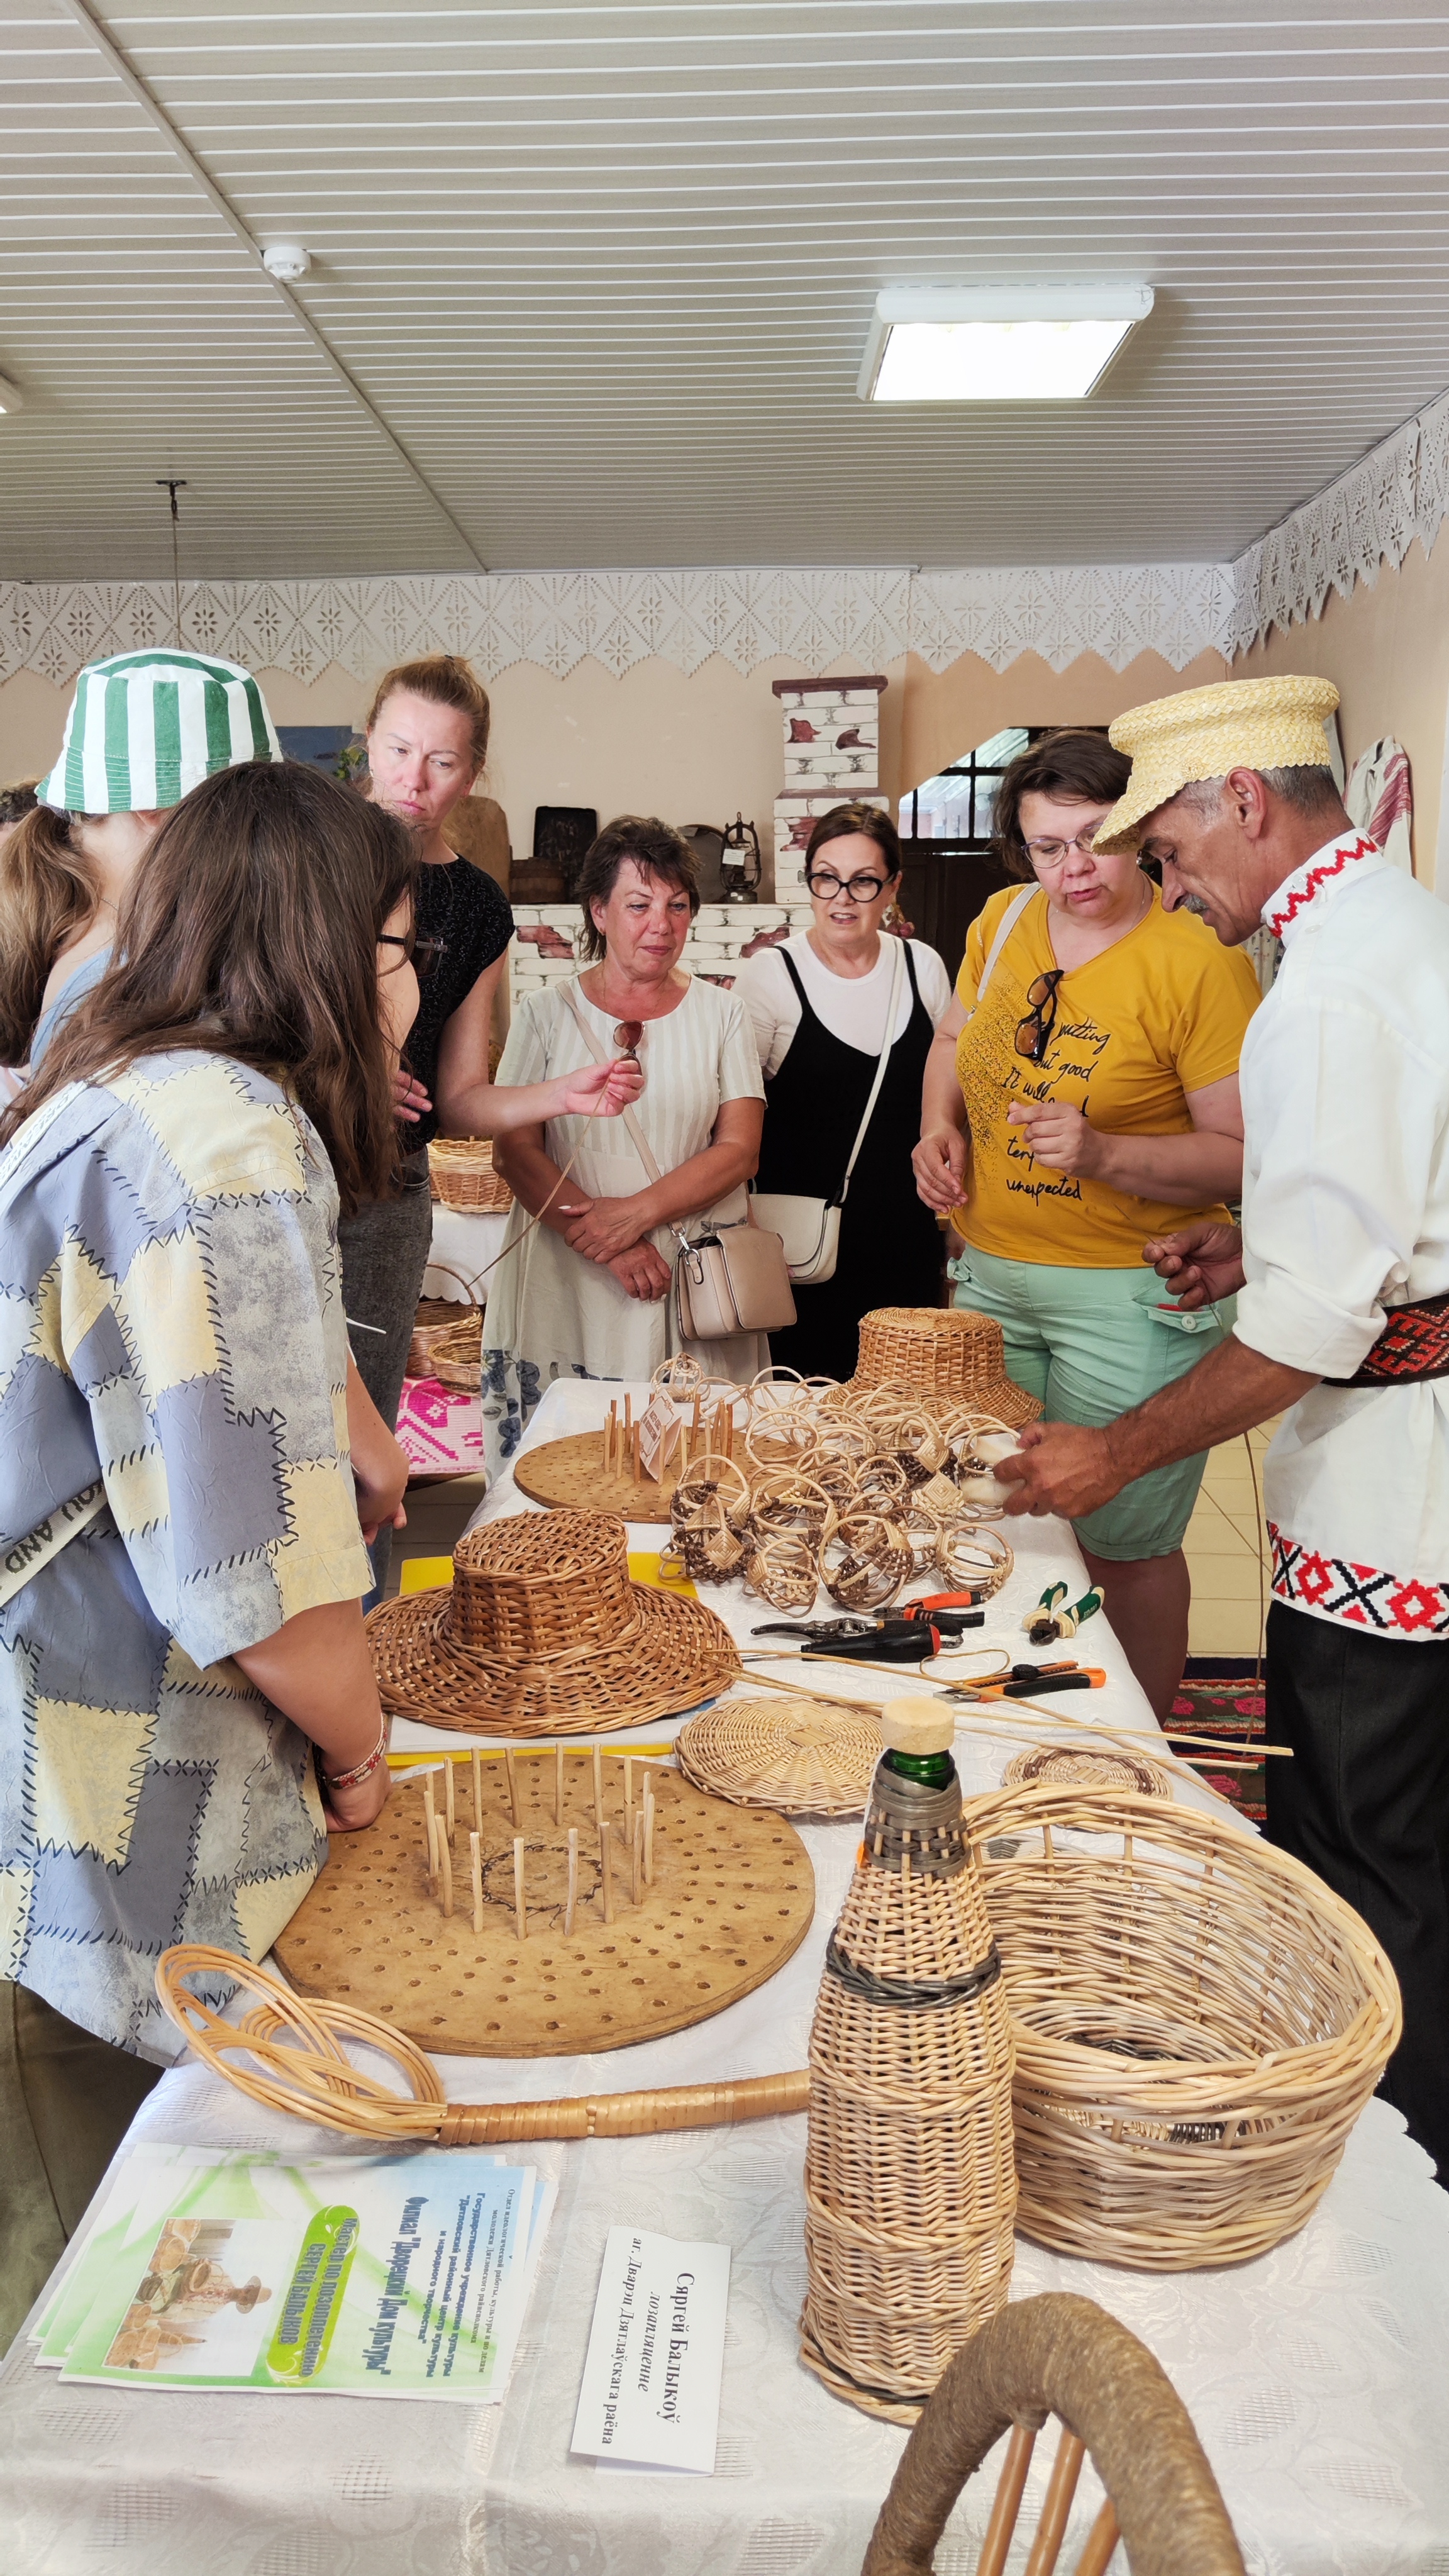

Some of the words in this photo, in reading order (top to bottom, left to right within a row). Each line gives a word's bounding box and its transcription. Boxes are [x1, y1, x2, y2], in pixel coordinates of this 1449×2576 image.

[1050, 1016, 1111, 1055] putting
[1001, 1067, 1021, 1089] It
[1023, 1081, 1052, 1103] will
[1051, 1060, 1099, 1084] good
[1006, 1176, 1082, 1207] unexpected
[5, 1519, 53, 1574] AND
[399, 2196, 430, 2235] Филиал
[506, 2189, 515, 2210] Отдел
[329, 2218, 358, 2263] Мастер
[452, 2194, 471, 2253] "Дятловский
[464, 2192, 486, 2272] Государственное
[487, 2209, 498, 2245] молодежи
[497, 2211, 513, 2268] идеологической
[631, 2237, 642, 2253] аг.
[293, 2243, 326, 2284] СЕРГЕЙ
[321, 2263, 343, 2280] по
[383, 2237, 422, 2296] "Дворецкий
[430, 2238, 446, 2287] народного
[442, 2255, 458, 2302] районный
[480, 2246, 494, 2292] Дятловского
[491, 2269, 502, 2298] работы,
[621, 2255, 642, 2306] Дварэц
[279, 2285, 313, 2345] БАЛЫКОВ
[377, 2297, 409, 2319] Дом
[418, 2288, 436, 2344] творчества"
[434, 2305, 448, 2331] центр
[452, 2274, 470, 2331] учреждение
[470, 2294, 486, 2343] райисполкома
[486, 2299, 497, 2329] культуры
[670, 2273, 695, 2333] Сяргей
[299, 2281, 338, 2377] лозоплетению
[362, 2321, 396, 2375] культуры"
[638, 2291, 660, 2392] лозапляценне
[426, 2333, 442, 2377] культуры
[443, 2333, 460, 2377] культуры
[479, 2351, 488, 2373] делам
[609, 2307, 635, 2399] Дзятлаўскага
[657, 2338, 688, 2423] Балыкоў
[602, 2404, 618, 2445] раёна
